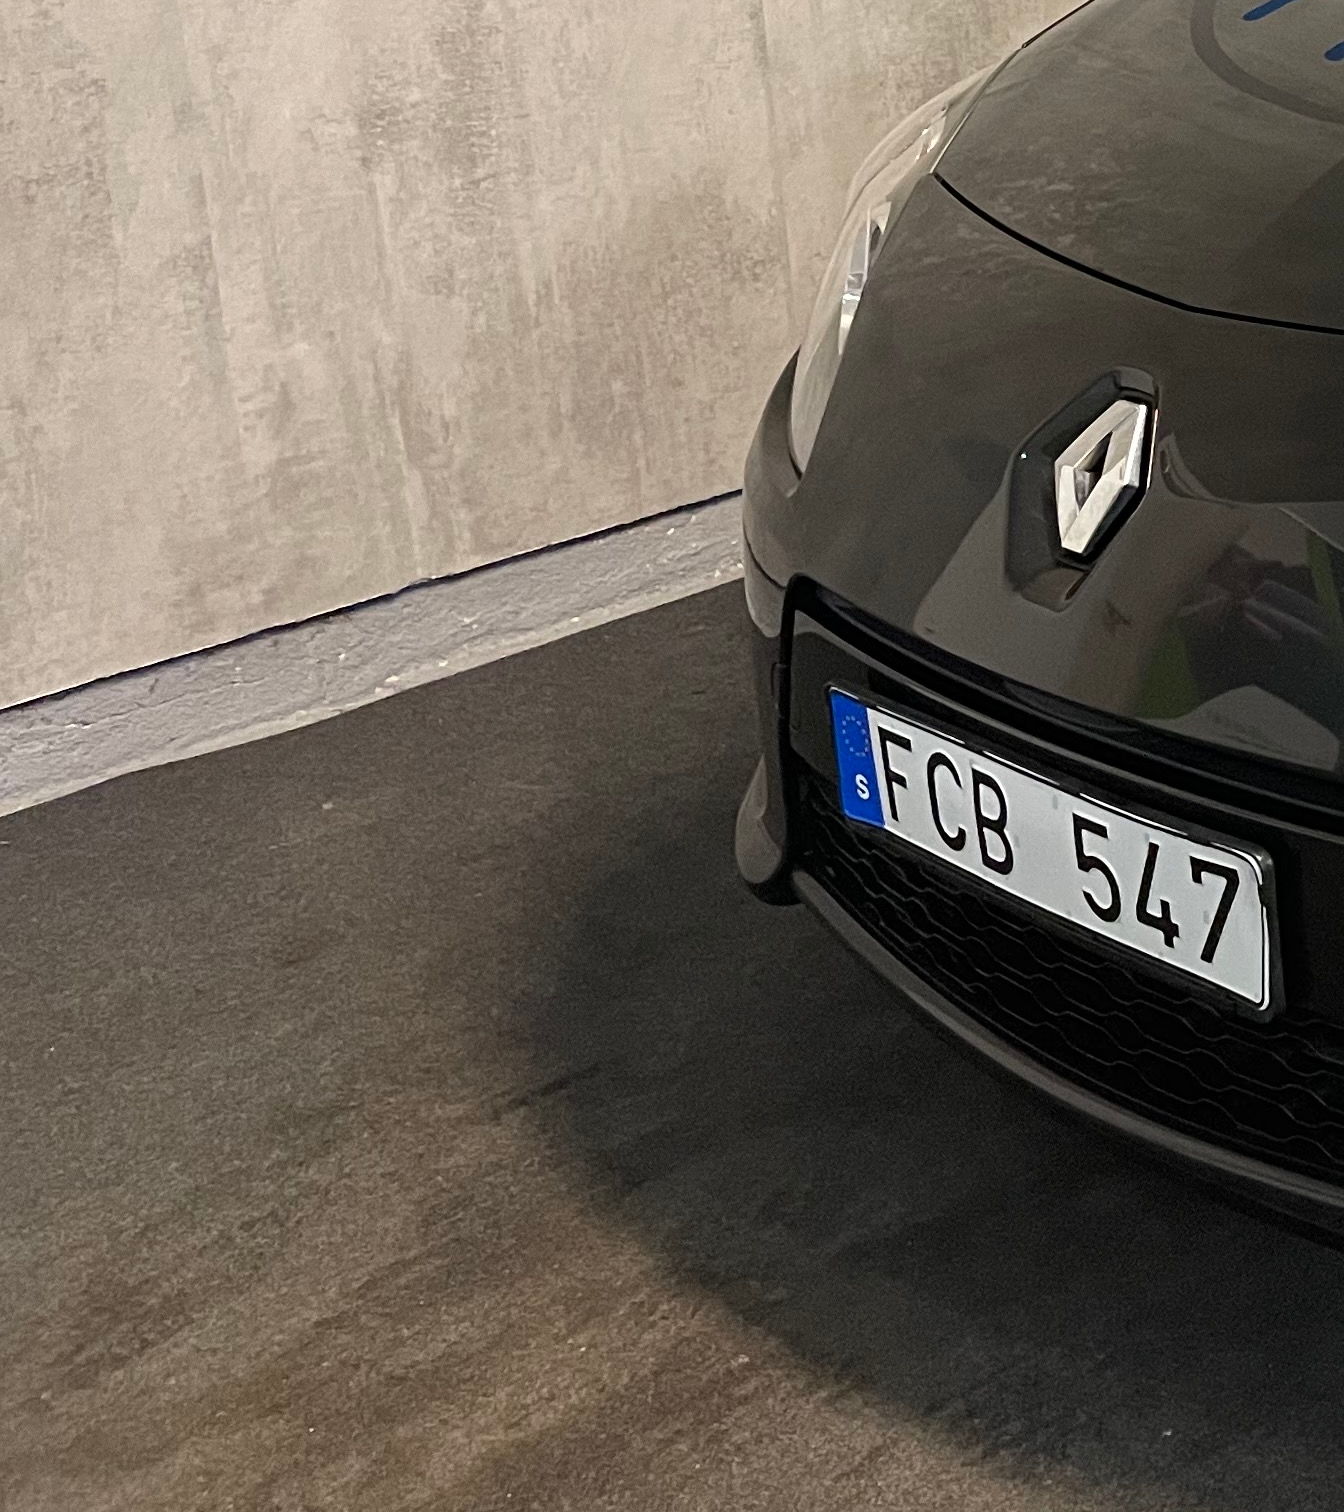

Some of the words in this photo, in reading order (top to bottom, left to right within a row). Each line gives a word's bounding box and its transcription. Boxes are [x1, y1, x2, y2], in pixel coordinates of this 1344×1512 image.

[855, 773, 870, 800] S
[877, 725, 1015, 876] FCB
[1071, 811, 1240, 965] 547
